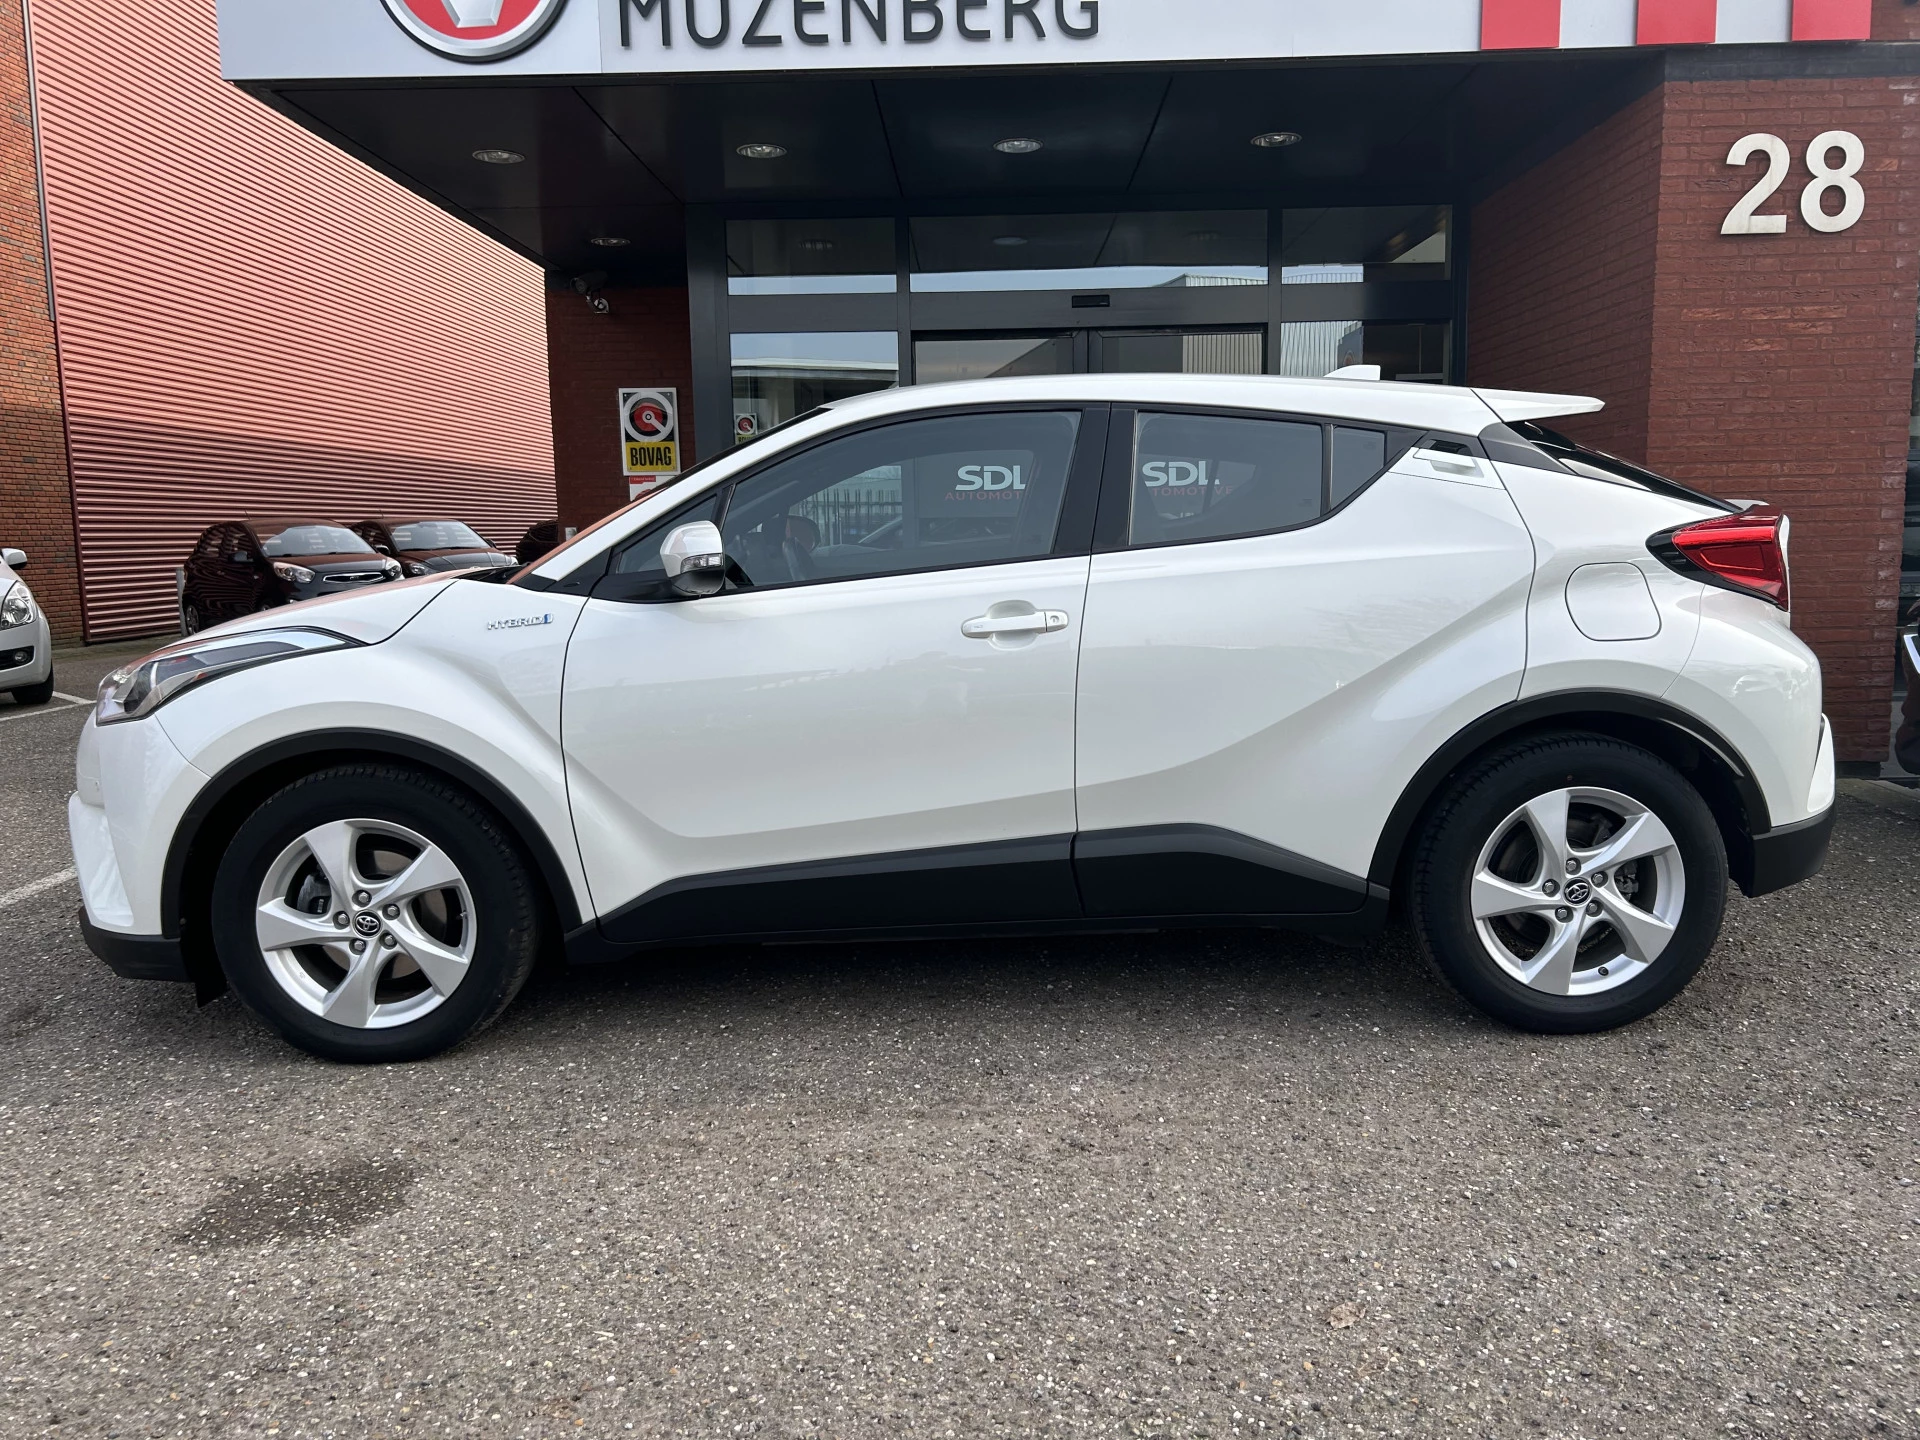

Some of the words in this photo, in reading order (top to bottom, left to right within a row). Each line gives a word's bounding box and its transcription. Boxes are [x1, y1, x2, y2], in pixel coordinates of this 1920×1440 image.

[1720, 130, 1865, 235] 28
[630, 446, 672, 467] BOVAG
[955, 465, 1026, 491] SDL
[1142, 460, 1220, 487] SDL
[945, 491, 1022, 501] AUTOMOT
[1152, 486, 1233, 497] TOMOTVE
[487, 615, 544, 631] HYBRID
